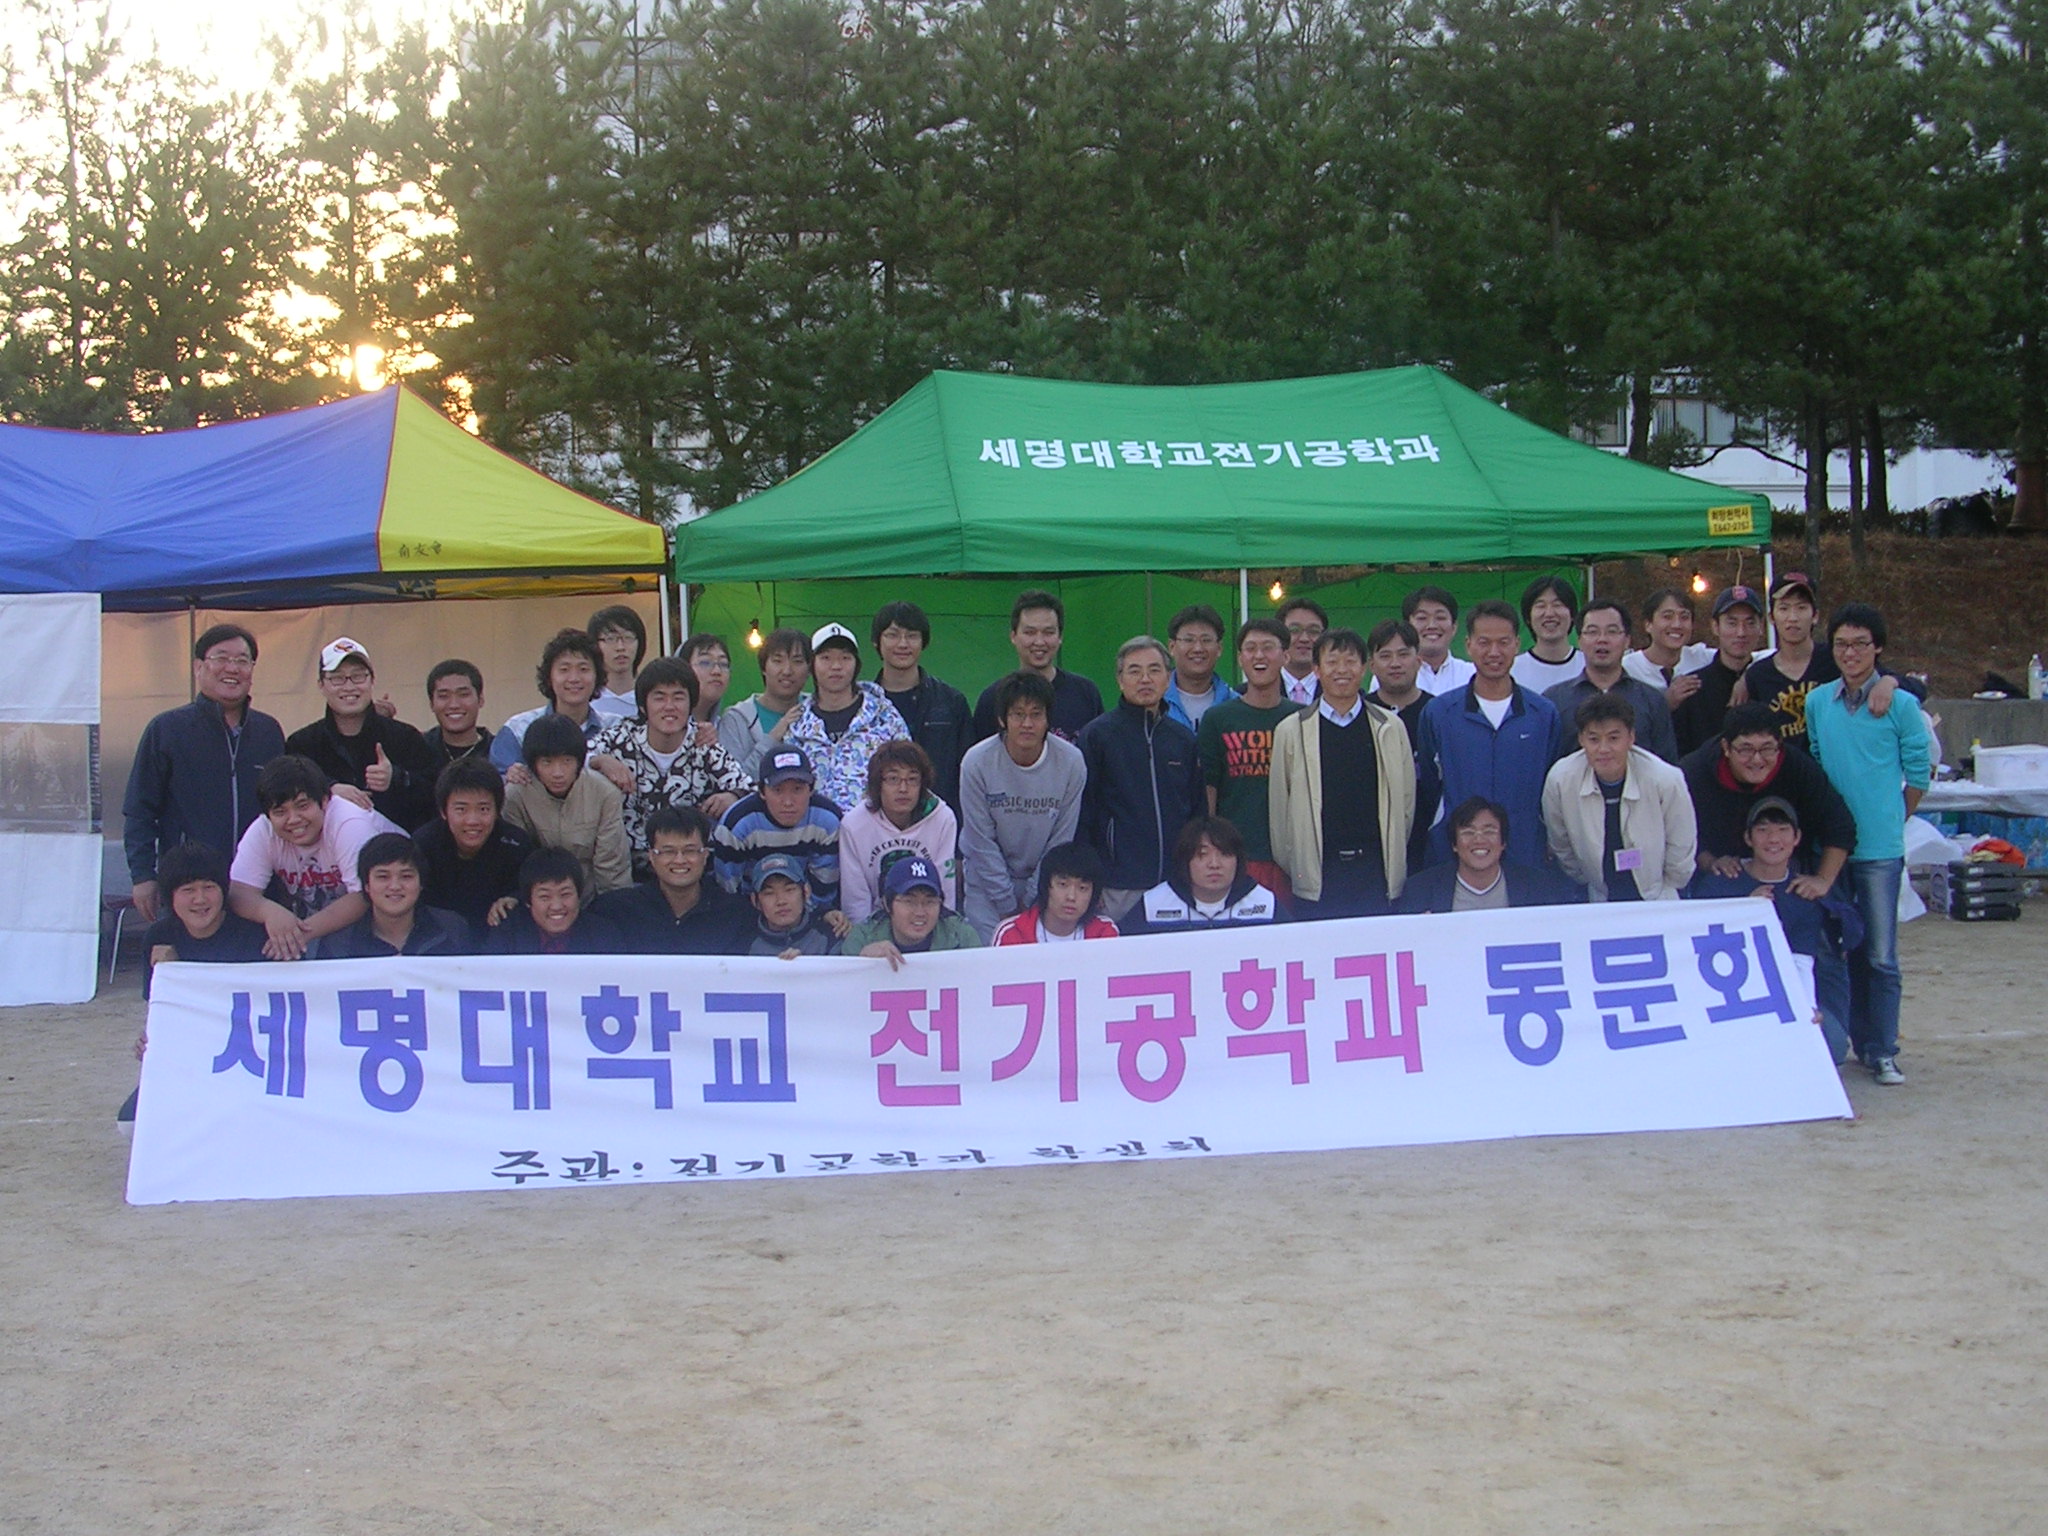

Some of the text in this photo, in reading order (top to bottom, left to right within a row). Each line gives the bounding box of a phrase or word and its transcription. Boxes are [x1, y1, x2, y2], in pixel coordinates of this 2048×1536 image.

[979, 434, 1441, 469] 세명대학교전기공학과
[211, 922, 1797, 1114] 세명대학교 전기공학과 동문회
